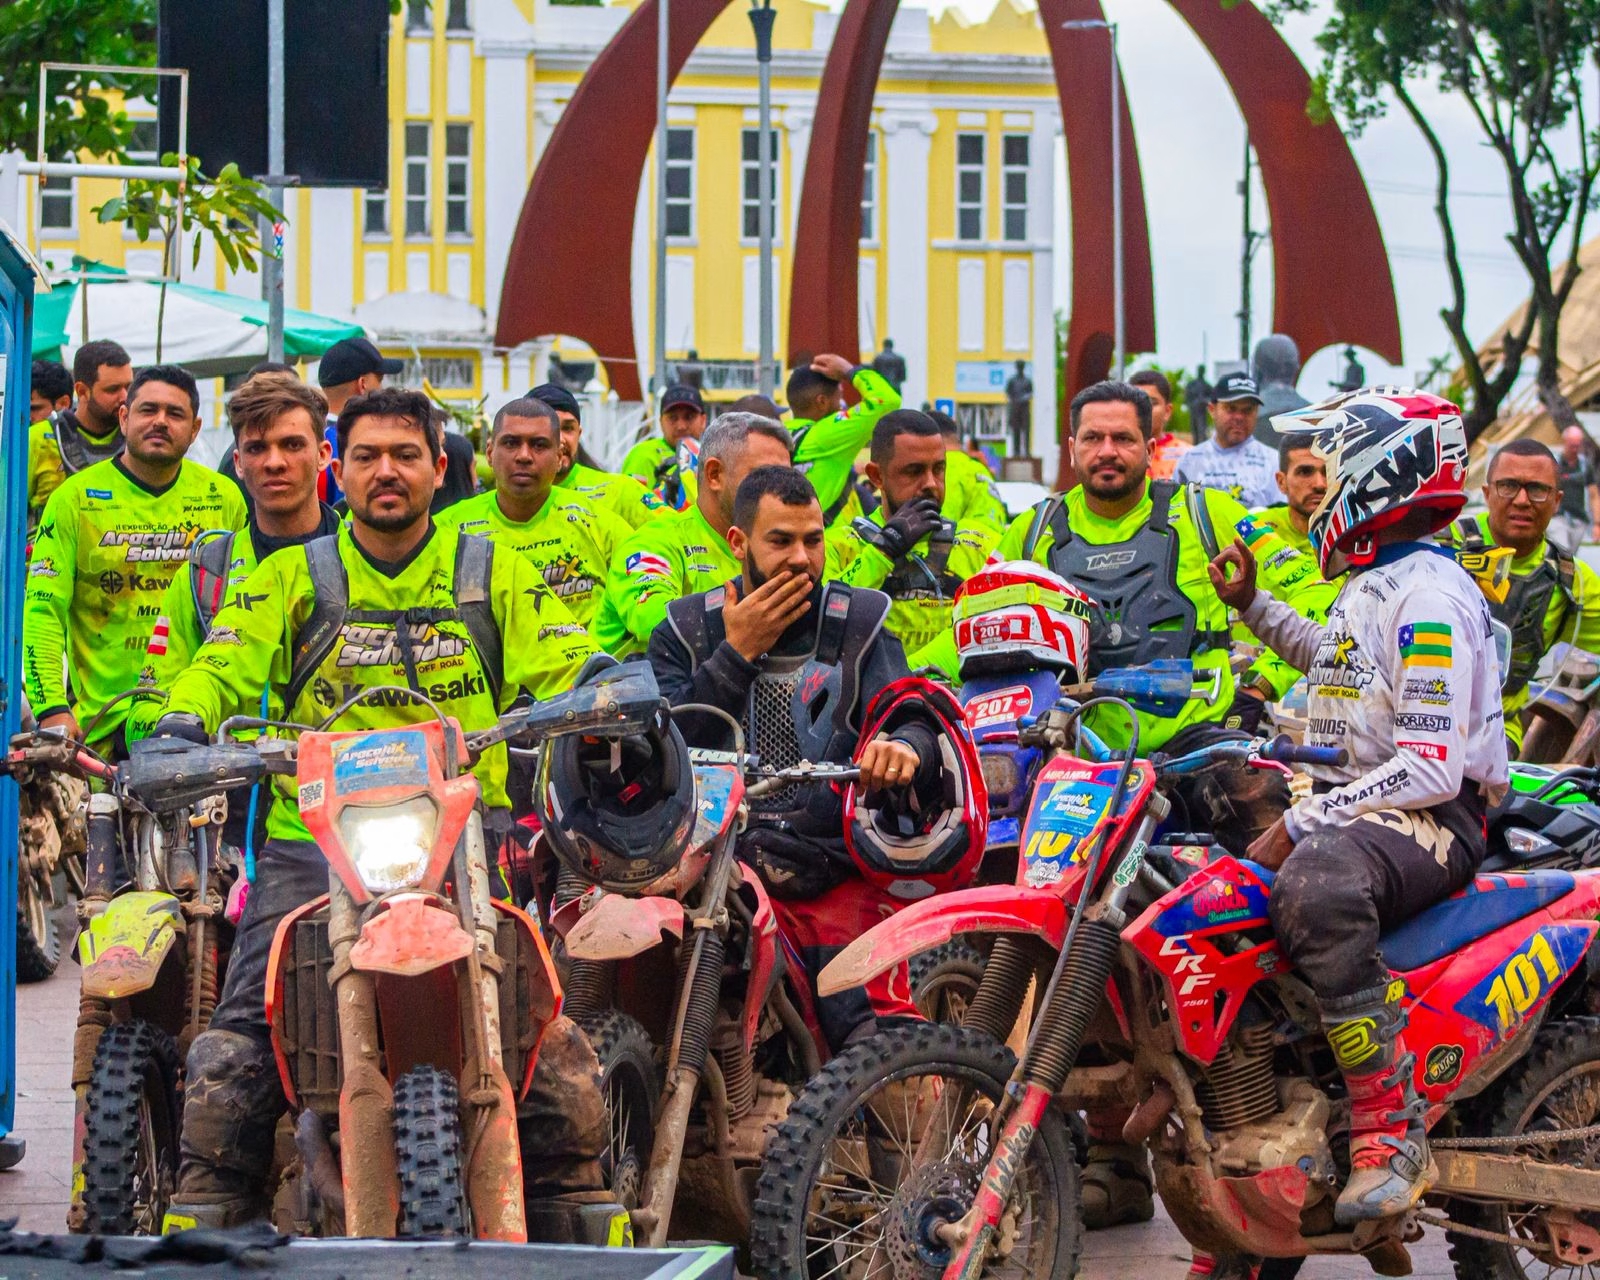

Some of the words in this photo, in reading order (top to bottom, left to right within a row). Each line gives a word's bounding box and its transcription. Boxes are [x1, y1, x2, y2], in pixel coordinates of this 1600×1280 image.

[516, 537, 562, 552] MATTOS
[980, 625, 1001, 639] 207
[440, 659, 465, 670] ROAD
[975, 695, 1014, 719] 207
[1043, 770, 1093, 781] MIRANDA
[1159, 933, 1217, 995] CRF
[1483, 932, 1561, 1029] 101
